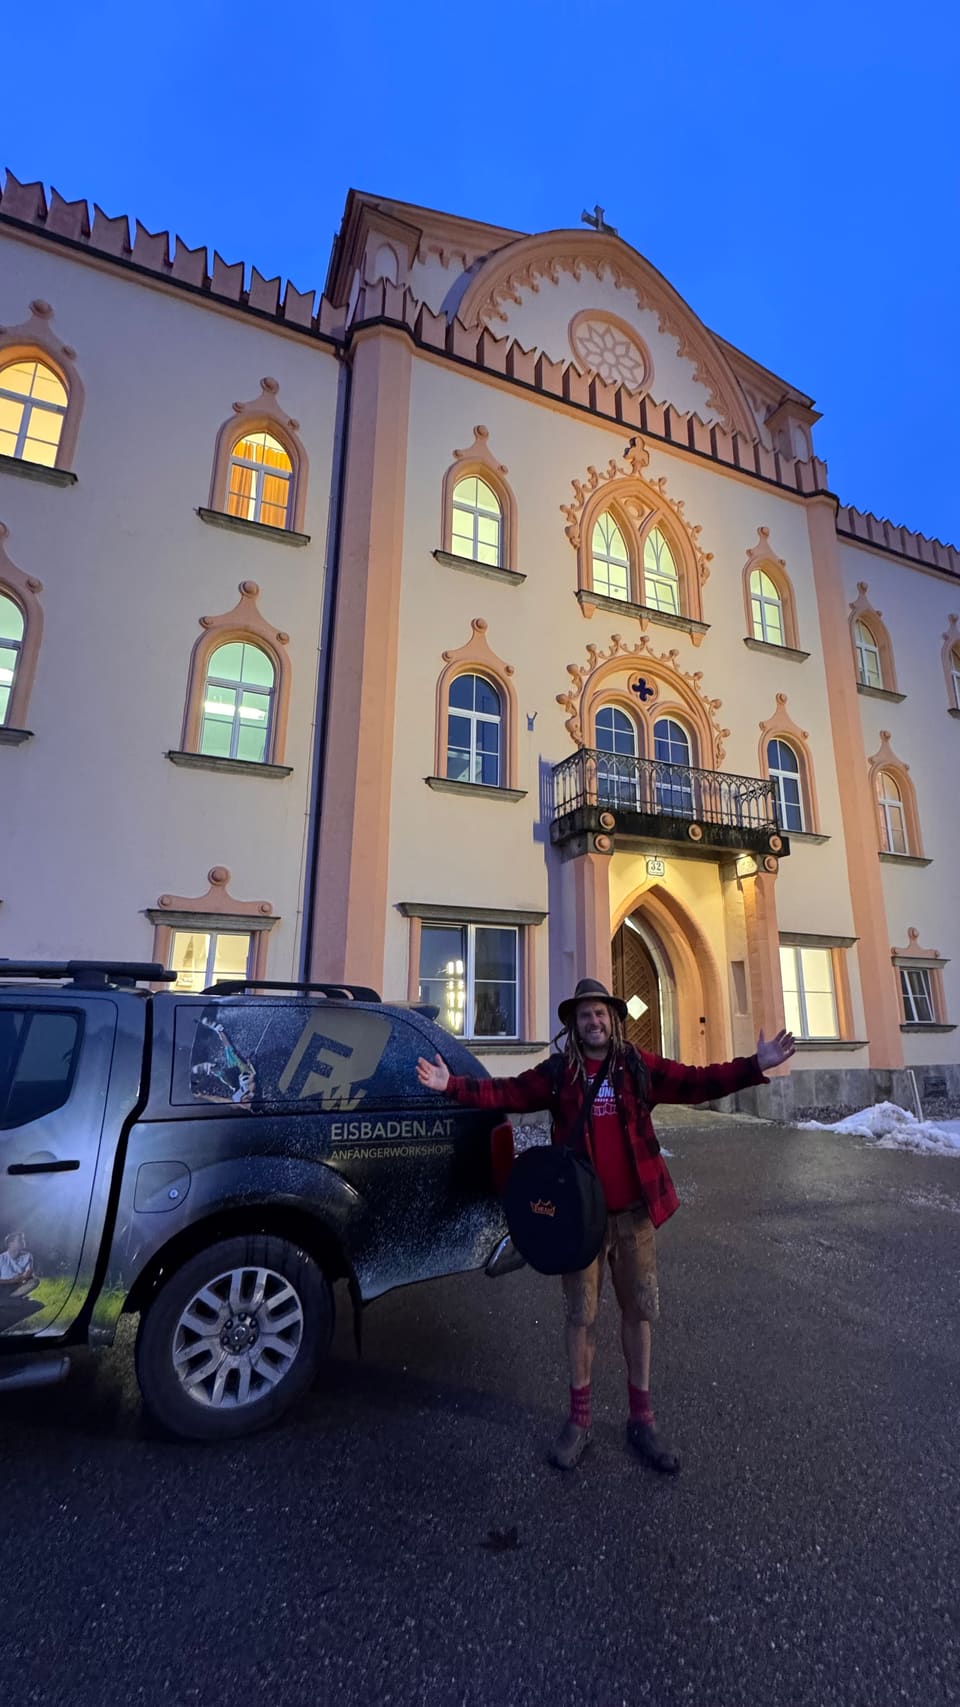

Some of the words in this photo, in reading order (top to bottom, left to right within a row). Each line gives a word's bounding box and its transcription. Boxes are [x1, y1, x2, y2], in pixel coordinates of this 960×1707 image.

[650, 861, 661, 871] 32
[331, 1119, 454, 1140] EISBADEN.AT
[331, 1144, 455, 1160] ANFÄNGERWORKSHOPS
